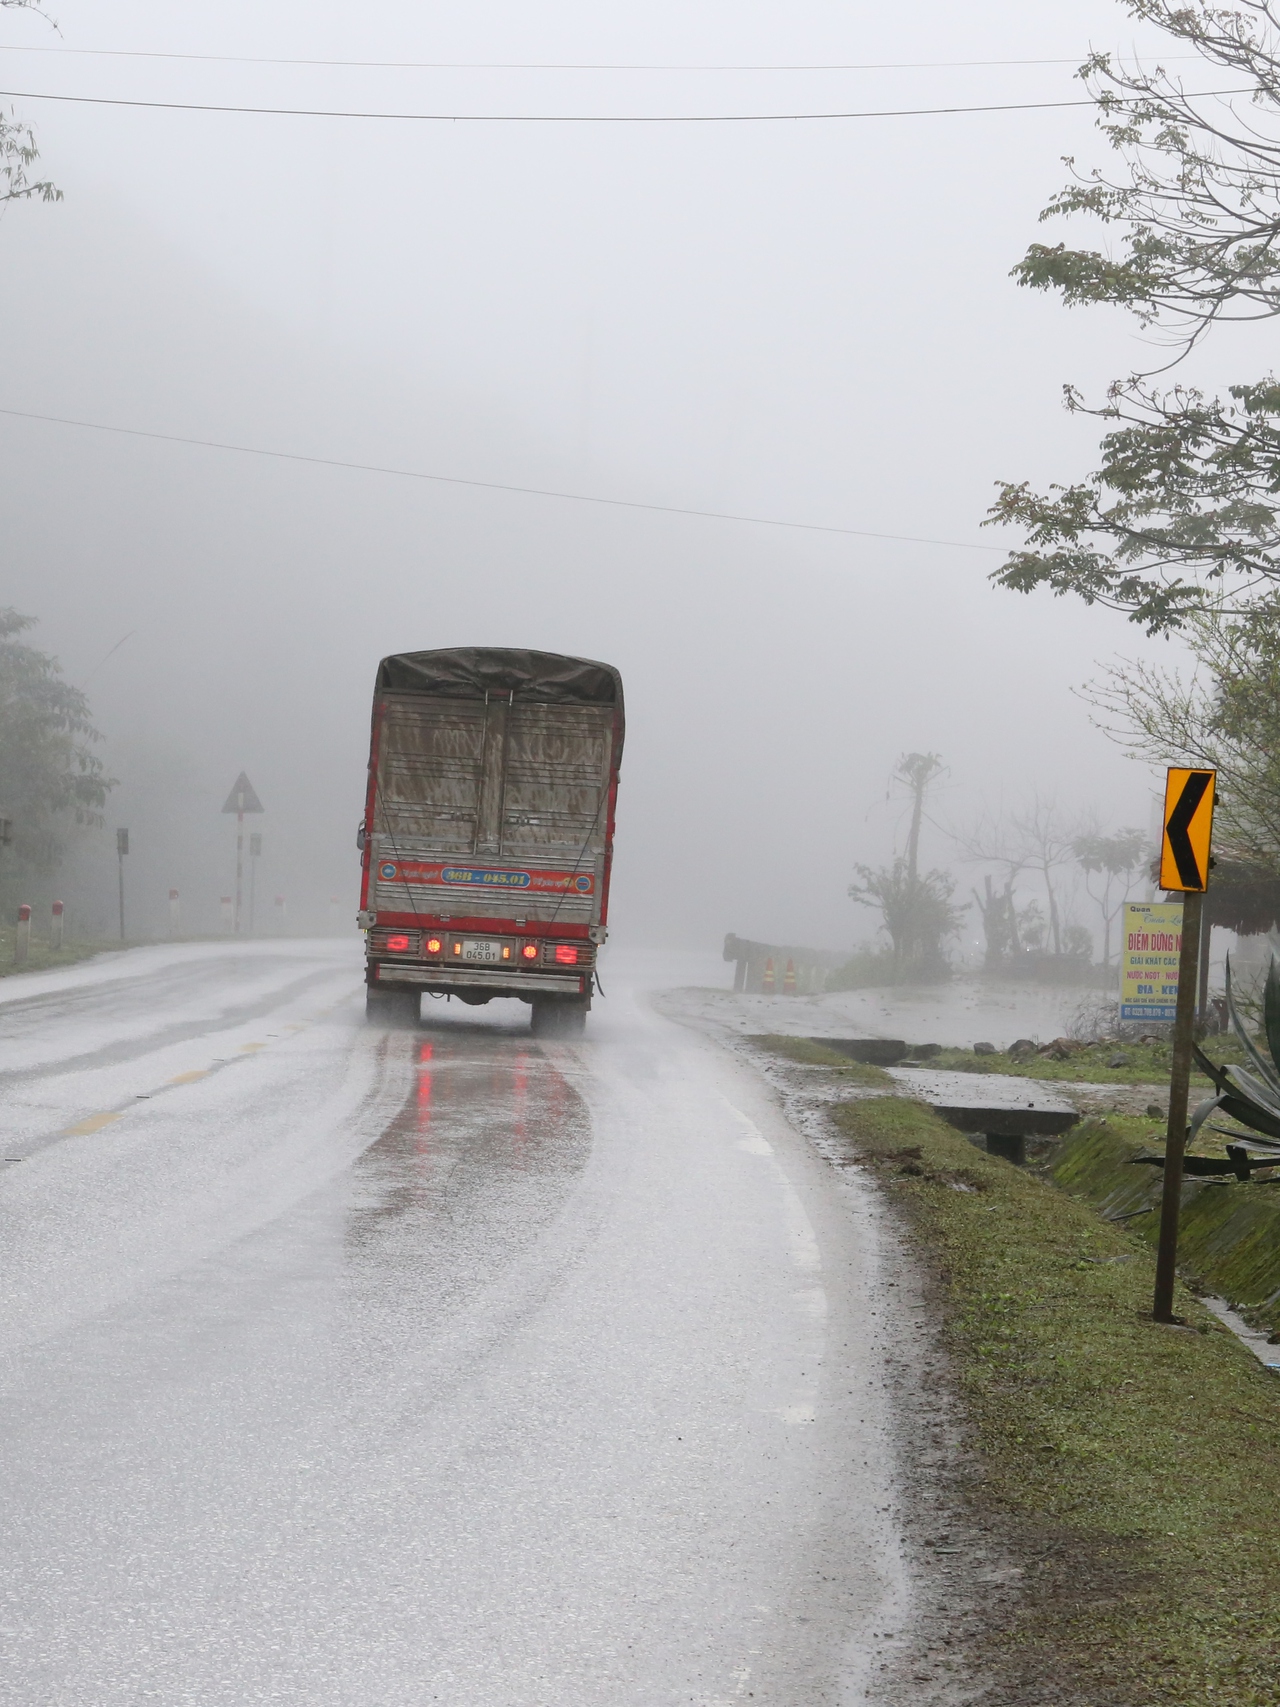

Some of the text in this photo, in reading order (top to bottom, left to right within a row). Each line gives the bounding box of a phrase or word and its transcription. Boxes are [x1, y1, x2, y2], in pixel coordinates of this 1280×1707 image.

[446, 870, 472, 881] 36B
[483, 873, 525, 885] 045.01
[1128, 926, 1149, 951] ĐIỂM
[1151, 930, 1174, 952] DỪNG
[473, 942, 491, 951] 36B
[466, 951, 496, 960] 045.01
[1137, 984, 1153, 995] BIA
